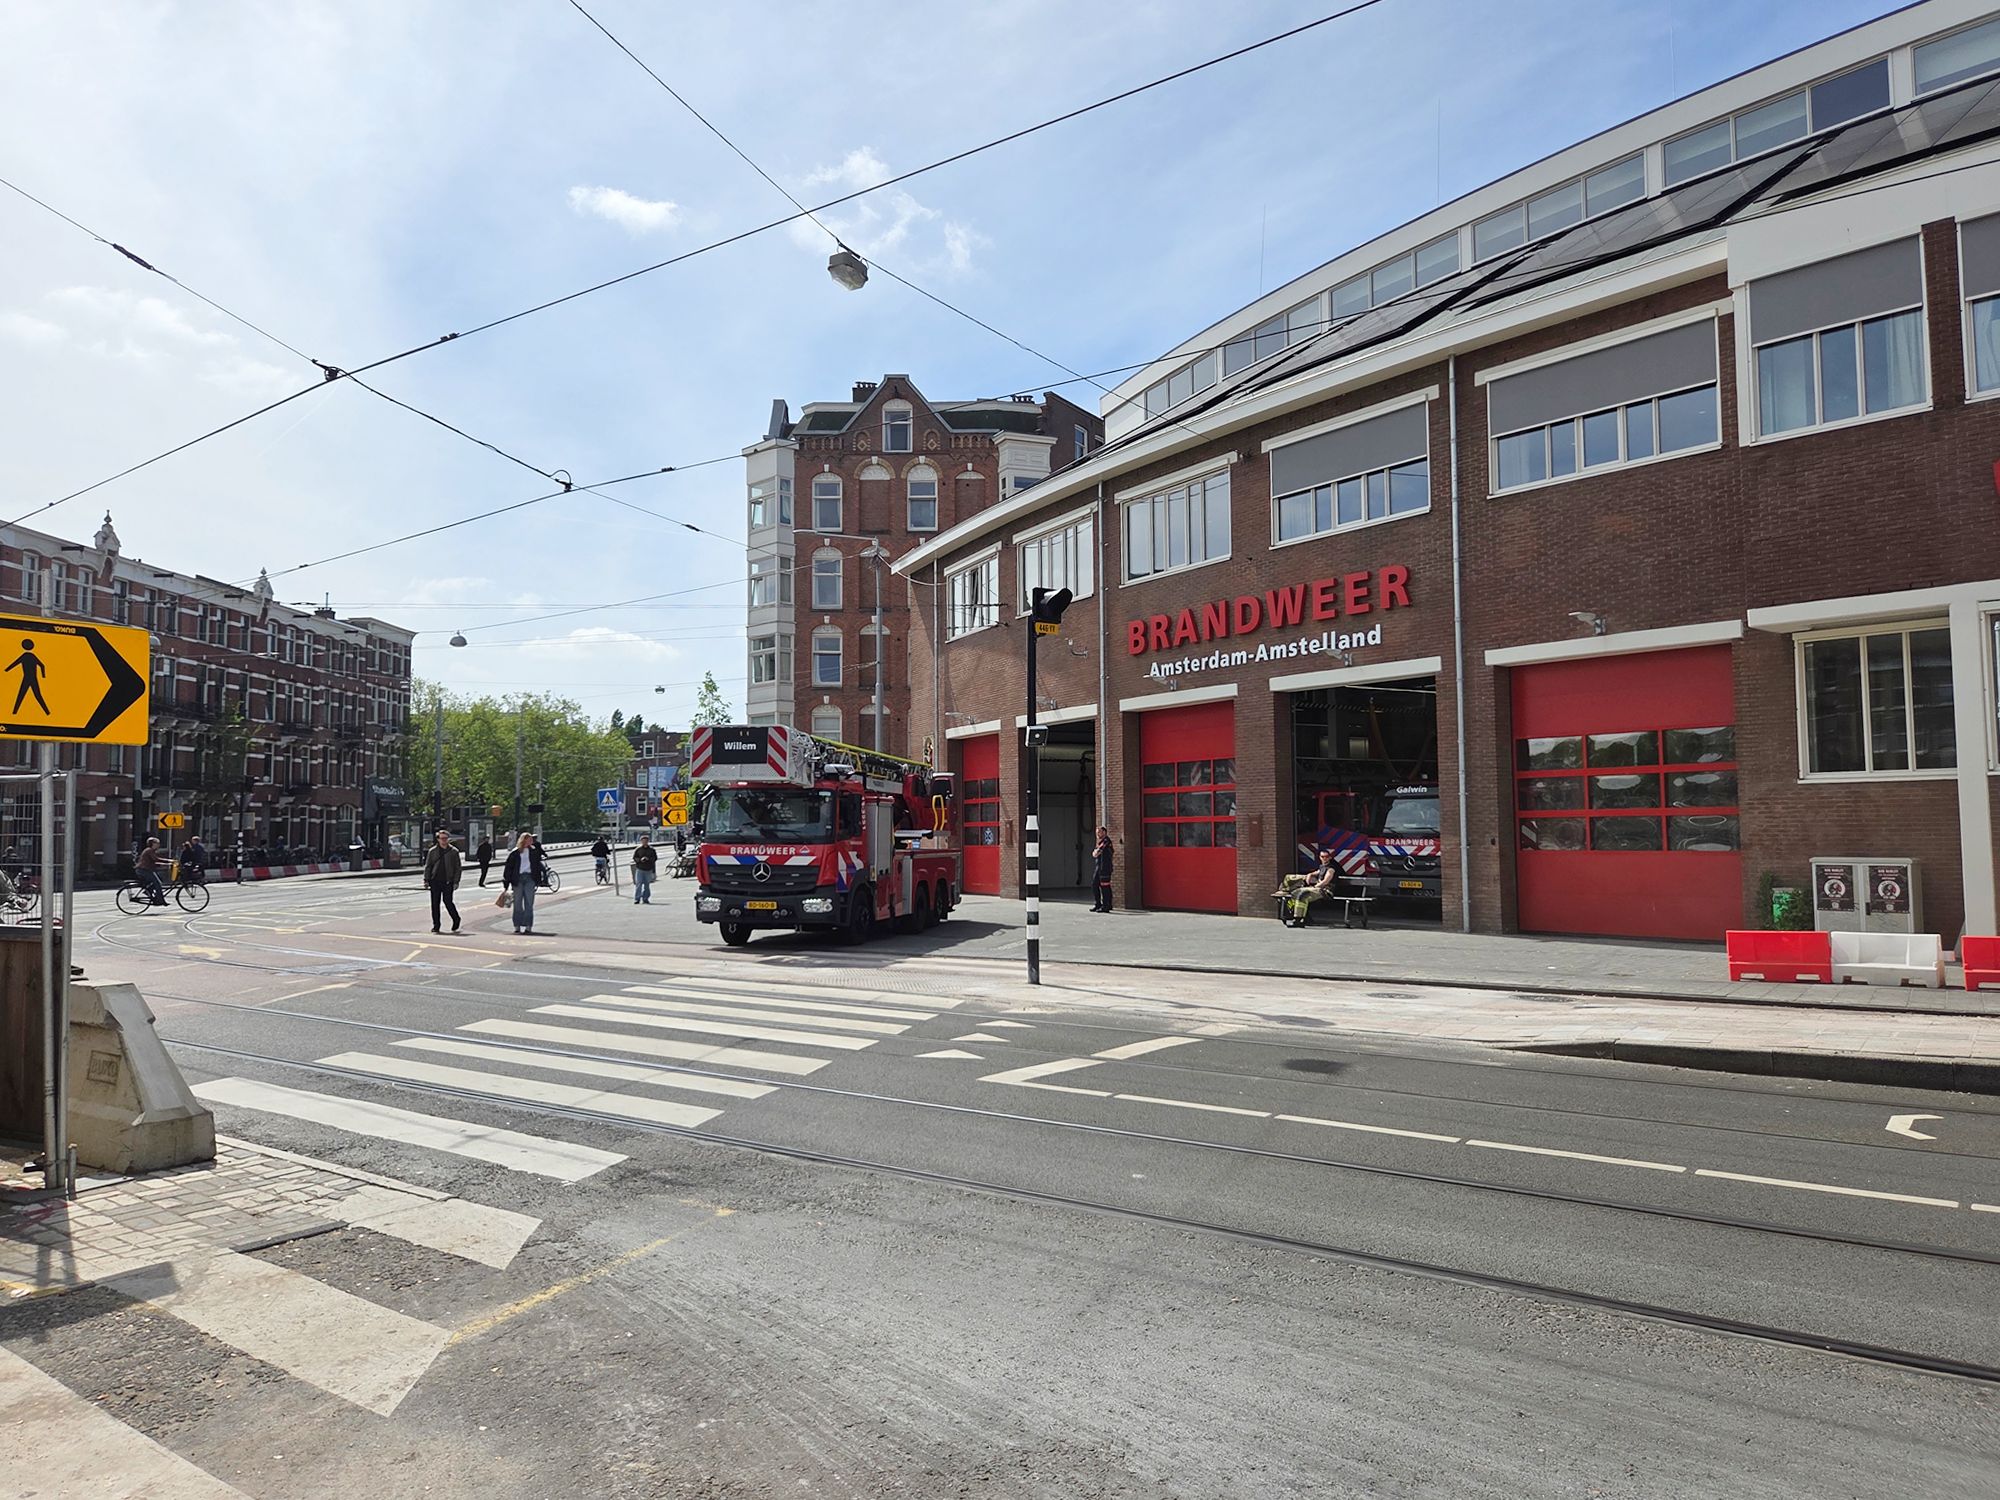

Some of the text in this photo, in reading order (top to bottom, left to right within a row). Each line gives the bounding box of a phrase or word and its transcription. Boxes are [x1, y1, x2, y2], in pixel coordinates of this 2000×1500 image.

[1127, 564, 1410, 656] BRANDWEER
[1149, 623, 1382, 678] Amsterdam-Amstelland
[723, 742, 757, 750] Willem
[1396, 785, 1428, 794] Galwin
[730, 845, 796, 855] BRANDWEER
